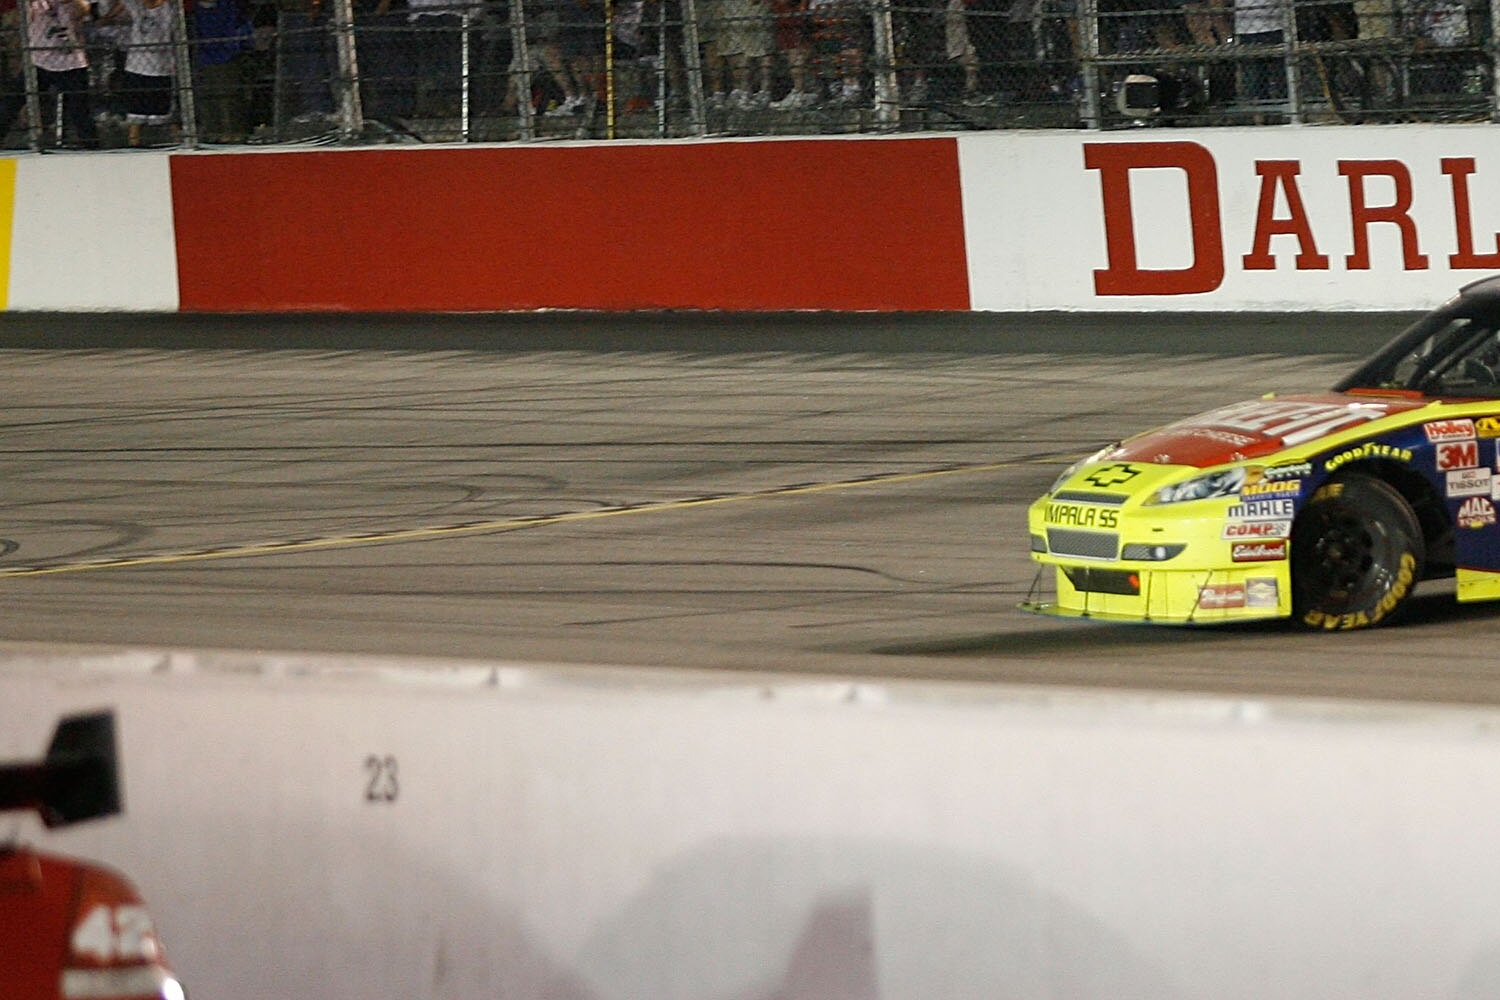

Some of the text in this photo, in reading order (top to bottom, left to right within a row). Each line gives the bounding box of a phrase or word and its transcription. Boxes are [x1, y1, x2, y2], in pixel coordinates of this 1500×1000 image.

[1439, 443, 1477, 469] 3M
[1242, 480, 1301, 496] MOOG
[1449, 478, 1489, 490] TISSOT
[1044, 504, 1120, 528] IMPALA SS
[363, 753, 400, 802] 23
